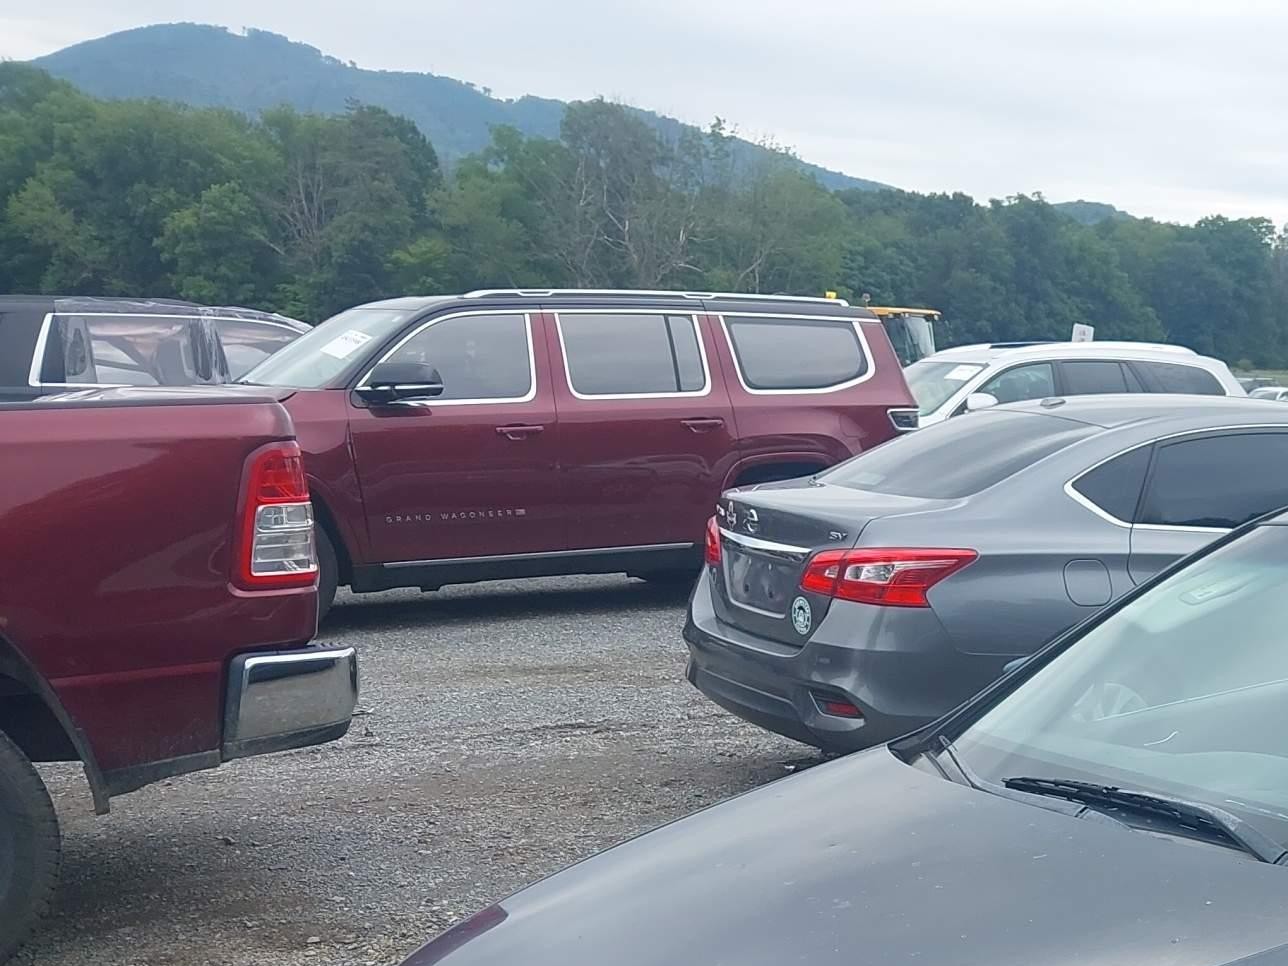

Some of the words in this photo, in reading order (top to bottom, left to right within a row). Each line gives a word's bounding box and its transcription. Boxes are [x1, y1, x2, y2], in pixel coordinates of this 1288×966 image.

[386, 514, 432, 523] GRAND
[440, 508, 512, 521] WAGONEER
[829, 531, 848, 540] SV
